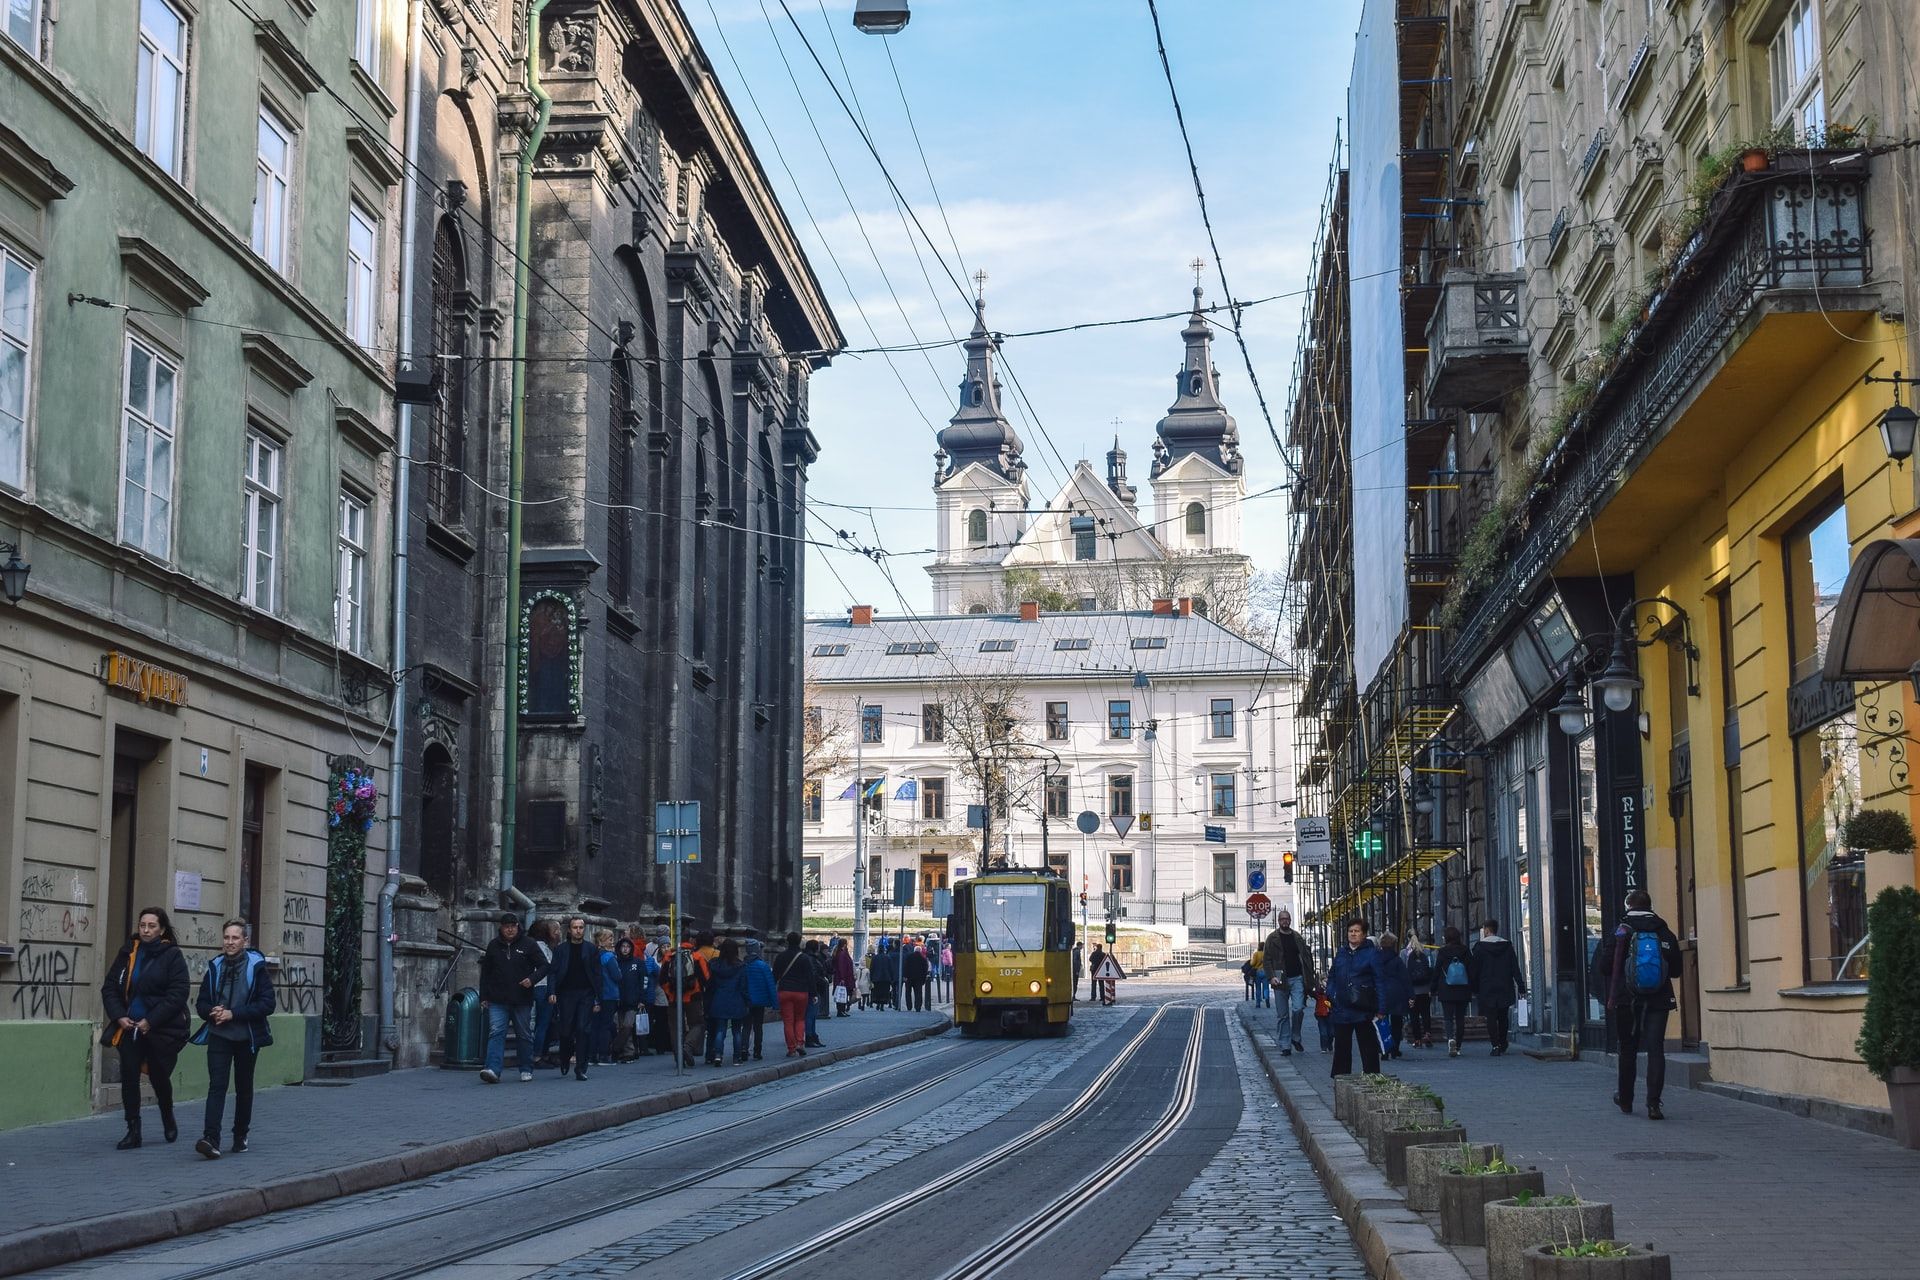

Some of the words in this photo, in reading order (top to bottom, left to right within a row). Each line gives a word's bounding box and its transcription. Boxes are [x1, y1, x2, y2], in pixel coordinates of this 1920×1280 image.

[117, 652, 189, 707] БІЖУТЕРІЯ
[1247, 902, 1270, 910] STOP
[999, 968, 1023, 977] 1075
